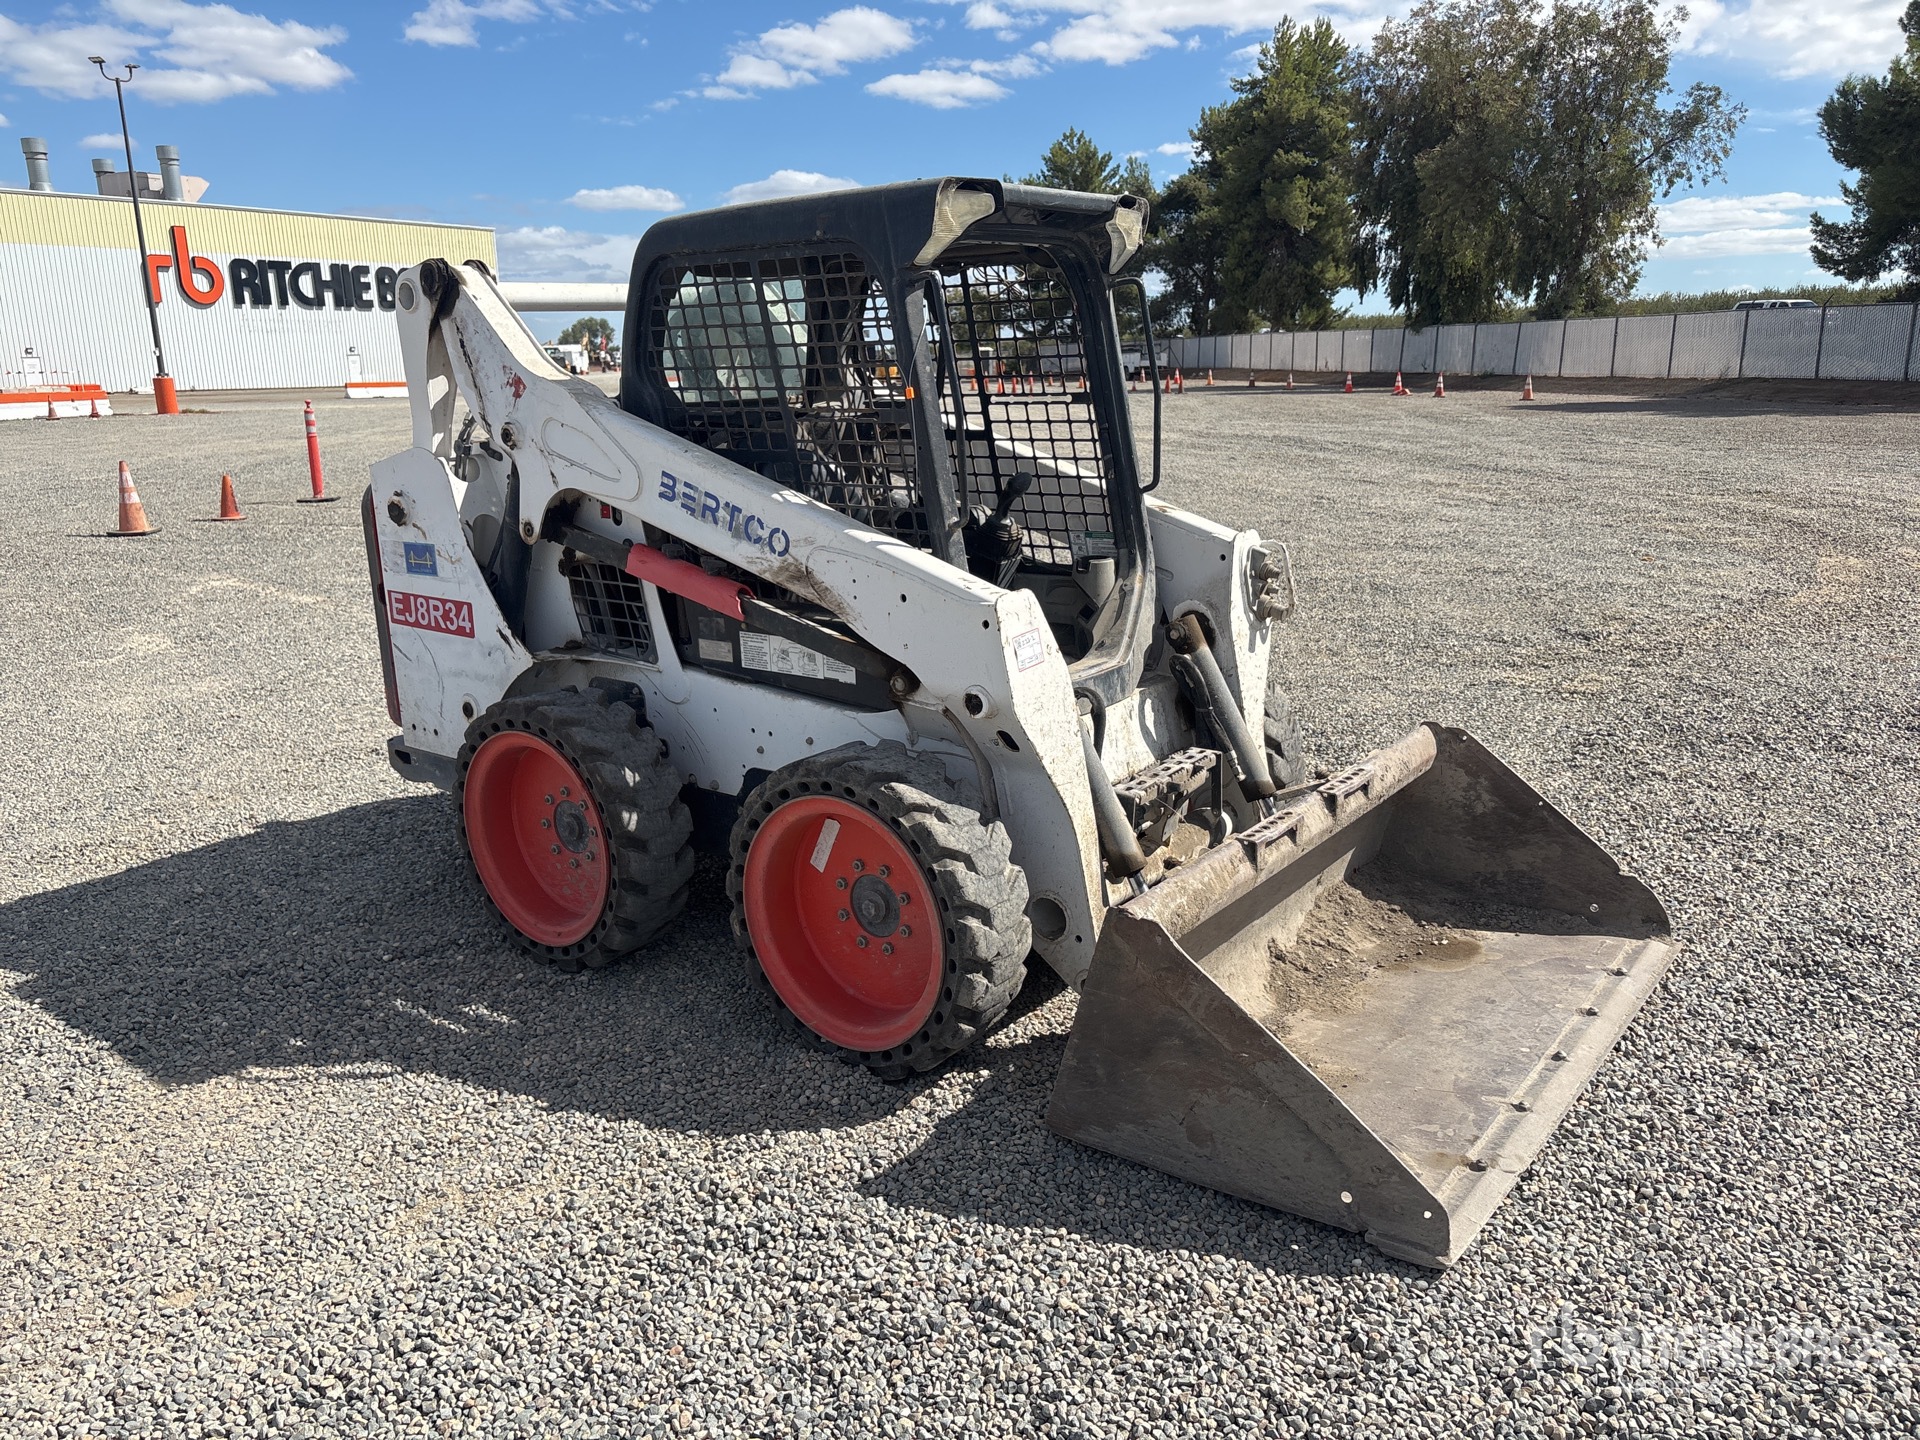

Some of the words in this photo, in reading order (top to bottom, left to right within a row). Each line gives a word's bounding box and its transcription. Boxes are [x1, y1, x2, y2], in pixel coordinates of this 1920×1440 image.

[230, 258, 374, 310] RITCHIE
[658, 470, 791, 558] BERTCO
[390, 591, 472, 633] EJ8R34
